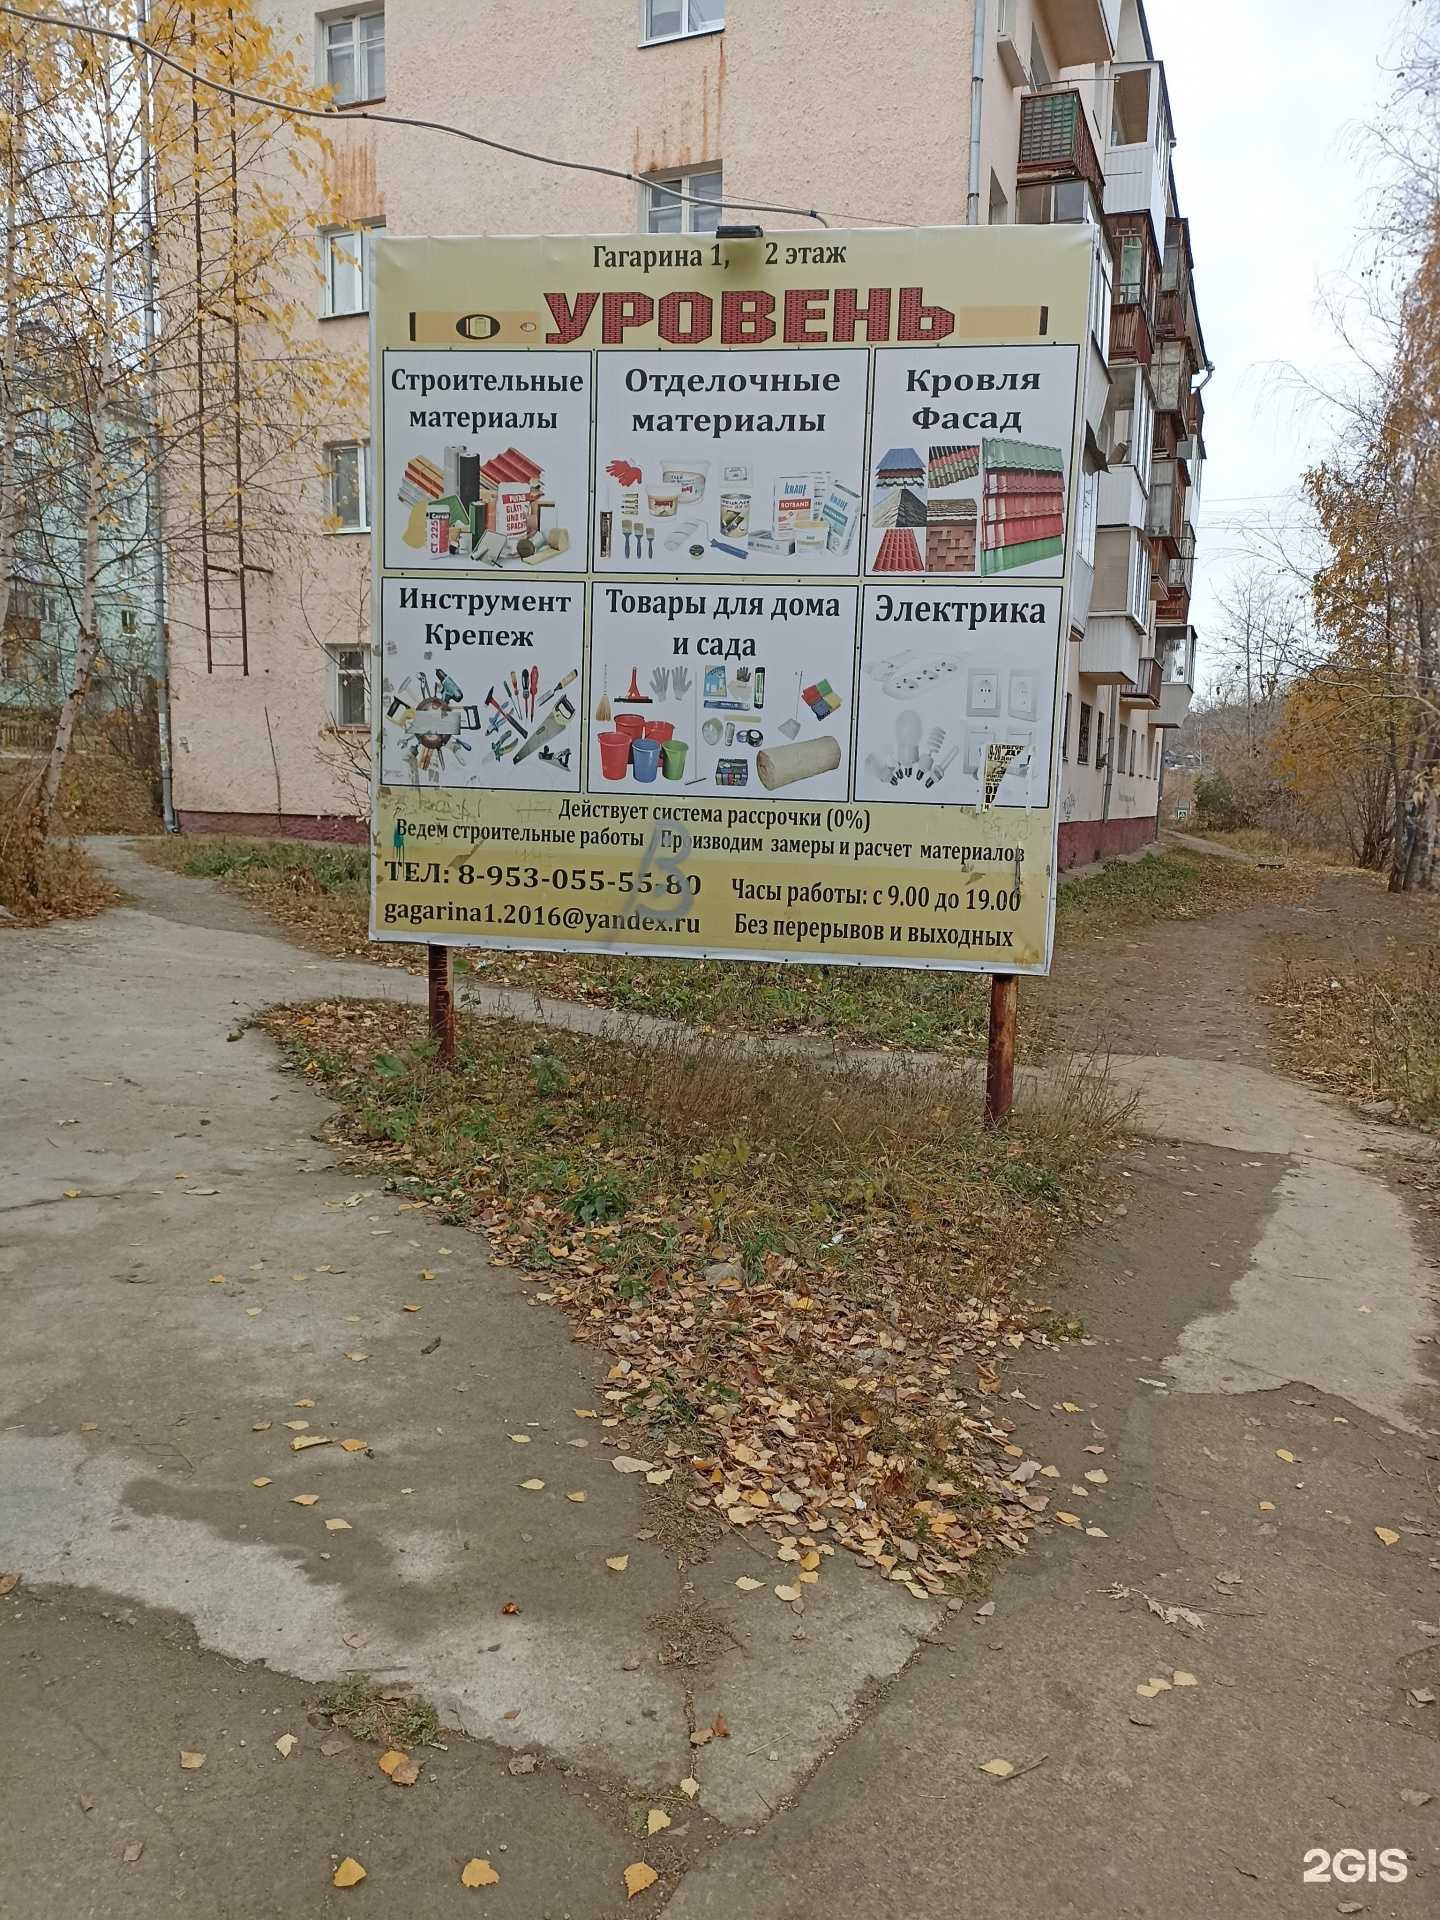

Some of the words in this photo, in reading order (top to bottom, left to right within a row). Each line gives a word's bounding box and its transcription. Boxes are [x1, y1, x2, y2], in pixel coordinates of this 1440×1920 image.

[593, 245, 703, 273] Гагарина
[711, 243, 730, 270] 1,
[764, 241, 778, 265] 2
[785, 246, 847, 265] этаж
[543, 287, 956, 345] УРОВЕНЬ
[391, 368, 584, 397] Строительные
[625, 368, 841, 397] Отделочные
[905, 369, 1041, 398] Кровля
[409, 410, 558, 434] материалы
[631, 413, 826, 439] материалы
[912, 406, 1022, 434] Фасад
[399, 587, 572, 617] Инструмент
[605, 588, 706, 621] Товары
[712, 596, 764, 620] для
[770, 597, 840, 622] дома
[875, 594, 1046, 628] Электрика
[425, 623, 534, 651] Крепеж
[672, 637, 689, 655] и
[696, 637, 756, 662] сада
[558, 798, 649, 825] Действует
[652, 806, 723, 823] система
[727, 809, 822, 830] рассрочки
[826, 807, 871, 834] (0%)
[396, 818, 449, 841] Ведем
[452, 825, 576, 848] строительные
[579, 826, 644, 849] работы
[770, 838, 835, 859] замеры
[839, 841, 850, 855] и
[853, 841, 913, 861] расчет
[920, 844, 1025, 865] материалов
[384, 859, 449, 884] ТЕЛ:
[731, 878, 782, 901] Часы
[787, 881, 867, 908] работы:
[872, 889, 883, 906] с
[887, 885, 930, 908] 9.00
[934, 892, 960, 913] до
[966, 886, 1022, 912] 19.00
[384, 901, 700, 934] gagarina1.2016@yandex.ru
[734, 913, 768, 935] Без
[773, 920, 885, 944] перерывов
[889, 925, 903, 942] и
[907, 926, 1014, 949] выходных
